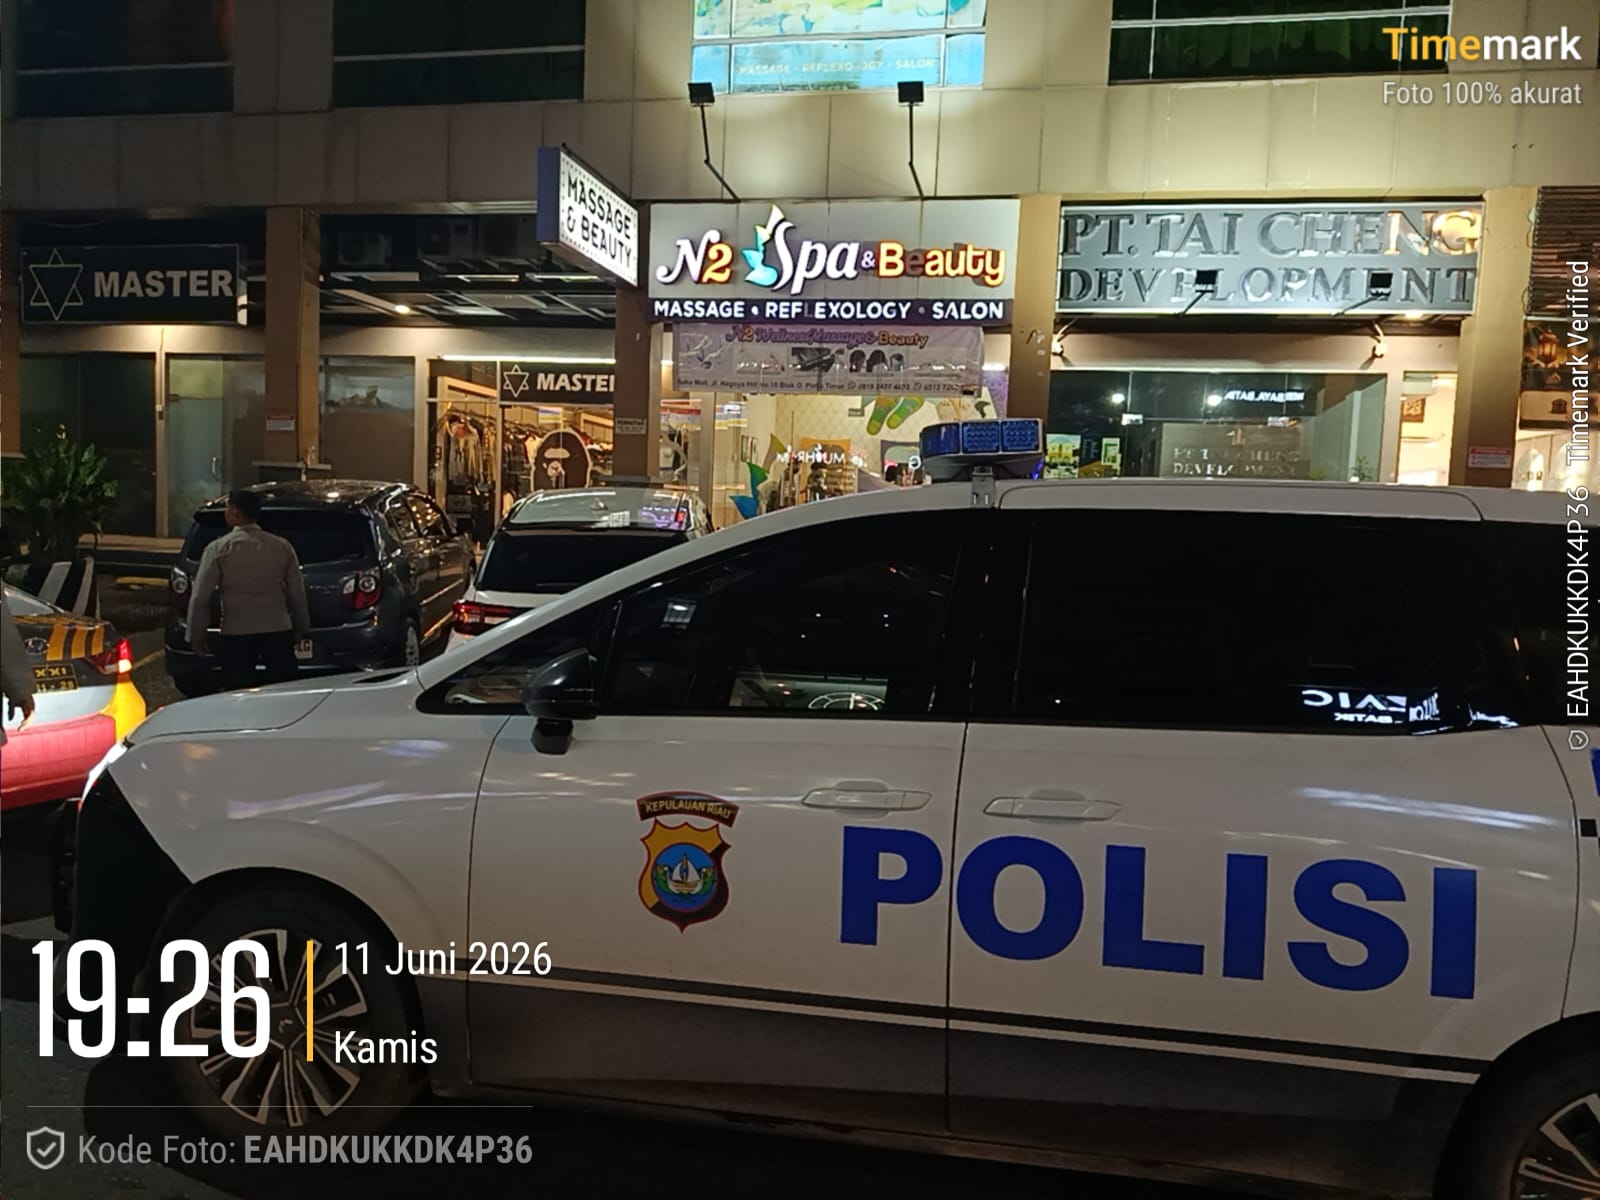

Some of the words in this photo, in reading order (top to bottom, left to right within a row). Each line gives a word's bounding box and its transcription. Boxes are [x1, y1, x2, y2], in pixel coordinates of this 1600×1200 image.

[568, 171, 632, 240] MASSAGE
[567, 205, 576, 233] &
[581, 214, 632, 268] BEAUTY
[1060, 213, 1140, 257] PT.
[1146, 212, 1244, 257] TAI
[1258, 209, 1483, 257] CHENG
[655, 229, 734, 285] N2
[771, 220, 861, 296] Spa
[861, 250, 876, 269] &
[878, 241, 1006, 288] Beauty
[94, 270, 233, 297] MASTER
[654, 301, 745, 317] MASSAGE
[765, 302, 911, 320] REFLEXOLOGY
[932, 302, 1004, 320] SALON
[878, 331, 929, 349] Beauty
[645, 800, 705, 813] KEPULAUAN
[707, 803, 731, 819] RIAU
[840, 825, 1477, 1000] POLISI
